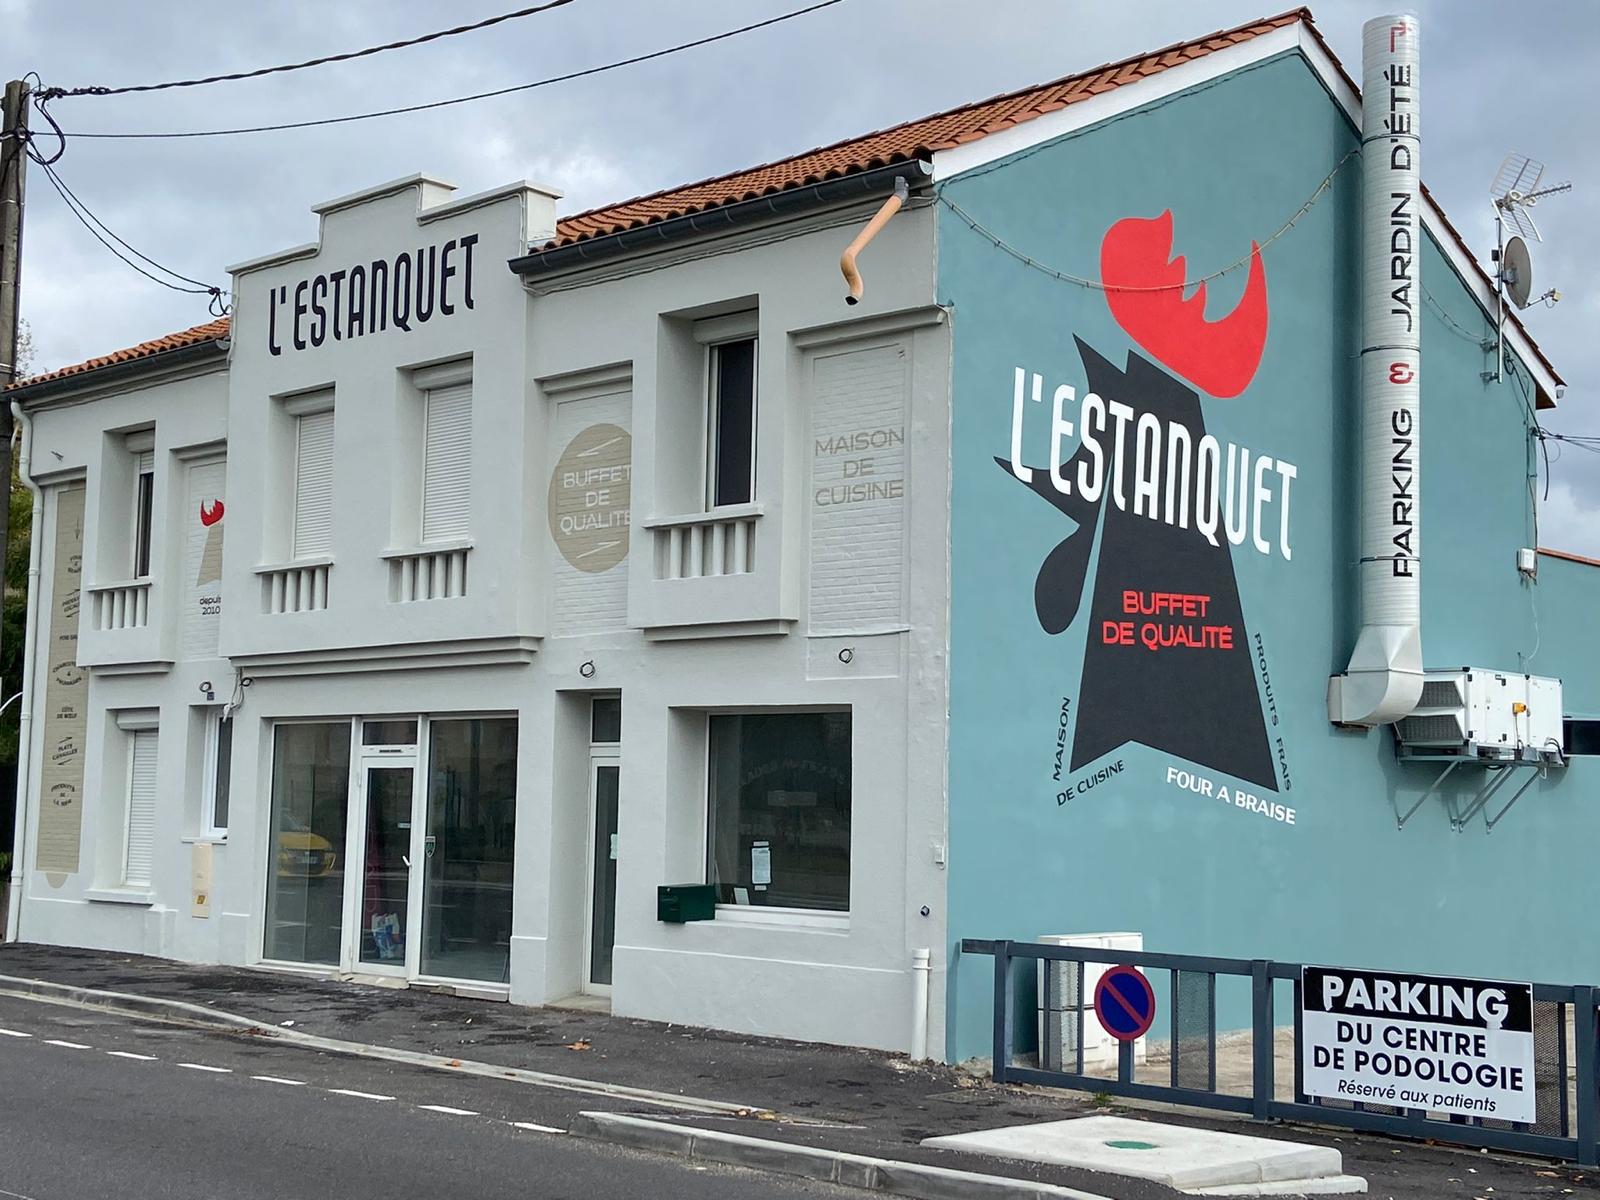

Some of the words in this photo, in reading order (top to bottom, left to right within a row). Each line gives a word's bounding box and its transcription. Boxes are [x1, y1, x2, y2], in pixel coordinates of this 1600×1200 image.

[1383, 64, 1412, 171] D'ÉTÉ
[1390, 192, 1413, 333] JARDIN
[269, 234, 479, 356] L'ESTANQUET
[815, 426, 905, 456] MAISON
[1010, 366, 1298, 562] L'ESTANQUET
[843, 457, 875, 478] DE
[585, 490, 611, 507] DE
[815, 479, 904, 506] CUISINE
[1391, 407, 1413, 578] PARKING
[202, 606, 221, 616] 2010
[1122, 590, 1211, 618] BUFFET
[1102, 621, 1136, 645] DE
[1254, 632, 1280, 727] PRODUITS
[1275, 737, 1292, 792] FRAIS
[1052, 696, 1072, 782] MAISON
[1056, 787, 1076, 806] DE
[1077, 759, 1126, 794] CUISINE
[1166, 766, 1213, 798] FOUR
[1216, 785, 1231, 804] A
[1234, 790, 1297, 825] BRAISE
[1322, 974, 1510, 1029] PARKING
[1337, 1020, 1373, 1045] DU
[1383, 1025, 1487, 1058] CENTRE
[1313, 1045, 1345, 1071] DE
[1354, 1049, 1524, 1092] PODOLOGIE
[1337, 1079, 1396, 1100] Réservé
[1400, 1088, 1428, 1104] aux
[1432, 1091, 1498, 1113] patients
